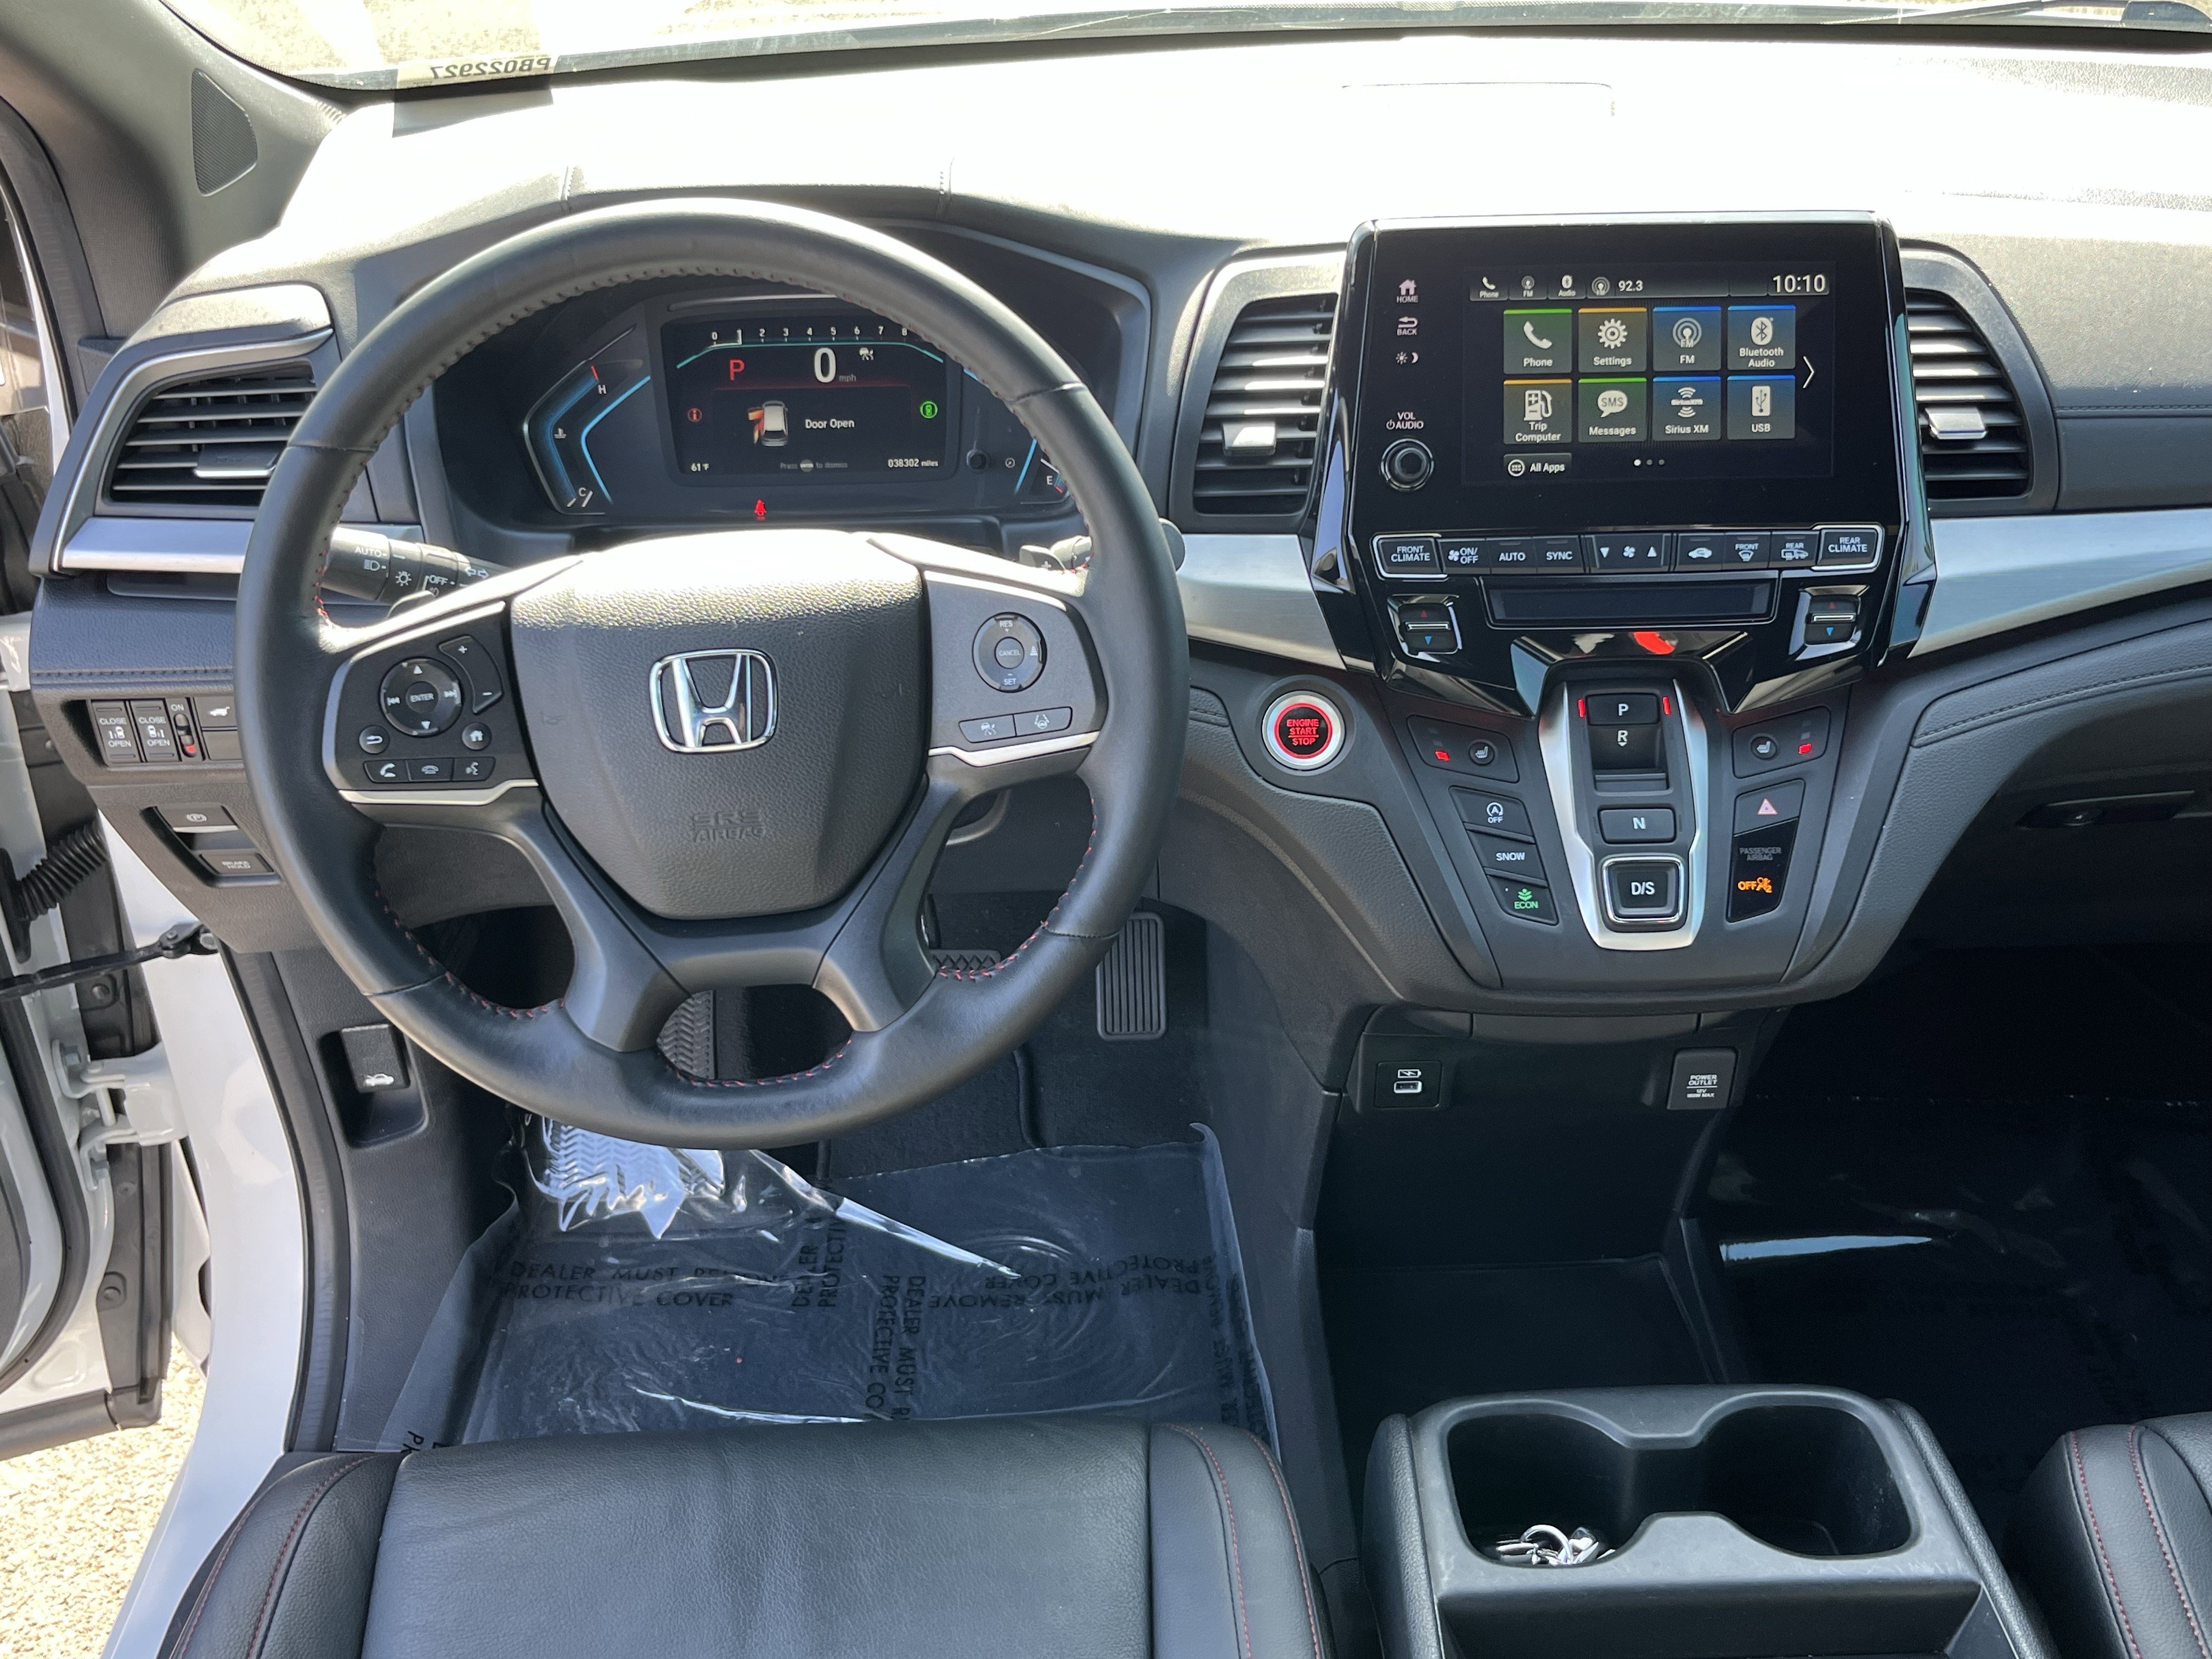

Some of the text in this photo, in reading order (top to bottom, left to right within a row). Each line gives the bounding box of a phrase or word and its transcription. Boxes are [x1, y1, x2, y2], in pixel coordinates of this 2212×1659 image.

[1618, 279, 1643, 292] 92.3
[1773, 274, 1827, 294] 10:10
[1396, 295, 1419, 303] HOME
[712, 331, 718, 341] 0
[759, 328, 765, 337] 2
[783, 328, 789, 337] 3
[807, 327, 813, 336] 4
[831, 326, 837, 336] 5
[854, 326, 860, 335] 6
[878, 325, 884, 335] 7
[901, 327, 908, 336] 8
[1739, 347, 1784, 357] Bluetooth
[1523, 357, 1553, 367] Phone
[1593, 357, 1632, 367] Settings
[1680, 355, 1695, 364] FM
[1748, 358, 1775, 368] Audio
[729, 359, 745, 381] P
[814, 347, 857, 383] 0 mph
[598, 385, 607, 394] H
[1601, 397, 1624, 408] SMS
[1397, 412, 1416, 421] VOL
[805, 418, 855, 431] Door Open
[1396, 421, 1425, 430] AUDIO
[1529, 421, 1548, 432] Trip
[1664, 424, 1709, 434] Sirius XM
[1751, 424, 1771, 433] USB
[1589, 427, 1637, 437] Messages
[1515, 433, 1561, 443] Computer
[888, 458, 938, 468] 038302 miles
[1530, 462, 1565, 473] All Apps
[1046, 475, 1053, 486] E
[579, 487, 586, 497] C
[1839, 536, 1860, 544] REAR
[1397, 545, 1424, 554] FRONT
[1785, 541, 1804, 550] REAR
[1828, 543, 1867, 554] CLIMATE
[356, 546, 382, 557] AUTO
[1460, 547, 1478, 556] ON/
[1546, 551, 1573, 561] SYNC
[1391, 552, 1431, 562] CLIMATE
[1460, 555, 1479, 565] OFF
[1499, 552, 1526, 562] AUTO
[428, 574, 448, 585] OFF
[1003, 678, 1017, 686] SET
[410, 692, 434, 703] ENTER
[171, 703, 184, 712] ON
[1618, 703, 1629, 716] P
[99, 717, 127, 726] CLOSE
[138, 716, 166, 725] CLOSE
[1286, 719, 1320, 727] ENGINE
[1289, 727, 1318, 735] START
[1617, 730, 1628, 742] R
[108, 740, 132, 748] OPEN
[146, 739, 171, 747] OPEN
[1292, 738, 1316, 746] STOP
[1633, 817, 1646, 830] N
[1496, 852, 1525, 861] SNOW
[1630, 882, 1655, 895] D/S
[1737, 881, 1757, 890] OFF
[1514, 900, 1539, 909] ECON
[509, 1261, 596, 1281] DEALER
[611, 1266, 679, 1281] MUST
[985, 1272, 1057, 1290] COVER
[1120, 1272, 1202, 1296] DEALER
[501, 1281, 734, 1307] PROTECTIVE COVER
[903, 1276, 927, 1334] DEALER
[870, 1274, 900, 1374] PROTECTIVE
[894, 1347, 917, 1395] MUST
